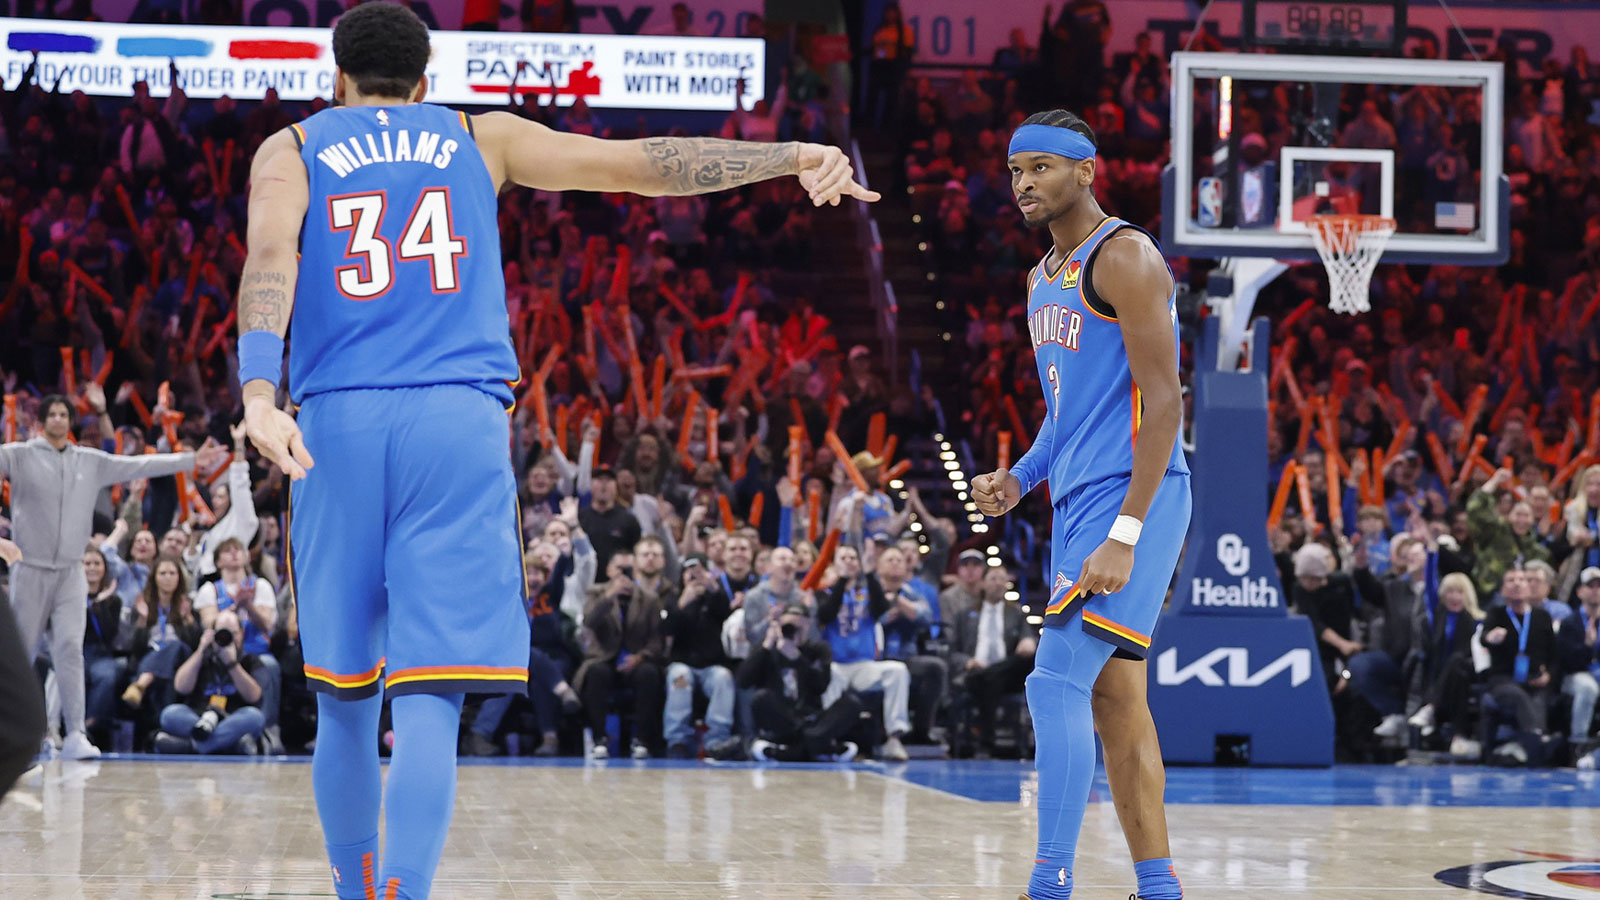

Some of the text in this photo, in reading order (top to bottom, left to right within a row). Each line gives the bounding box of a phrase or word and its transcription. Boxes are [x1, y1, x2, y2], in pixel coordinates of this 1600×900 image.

[467, 40, 595, 57] SPECTRUM
[624, 51, 755, 69] PAINT STORES
[66, 63, 122, 86] YOUR
[244, 69, 308, 90] PAINT
[467, 59, 569, 80] PAINT
[625, 75, 680, 94] WITH
[317, 129, 459, 179] WILLIAMS
[326, 186, 469, 301] 34
[1027, 302, 1084, 352] HUNDER
[1217, 533, 1251, 576] OU
[1191, 576, 1279, 608] Health
[1156, 646, 1312, 688] KIA
